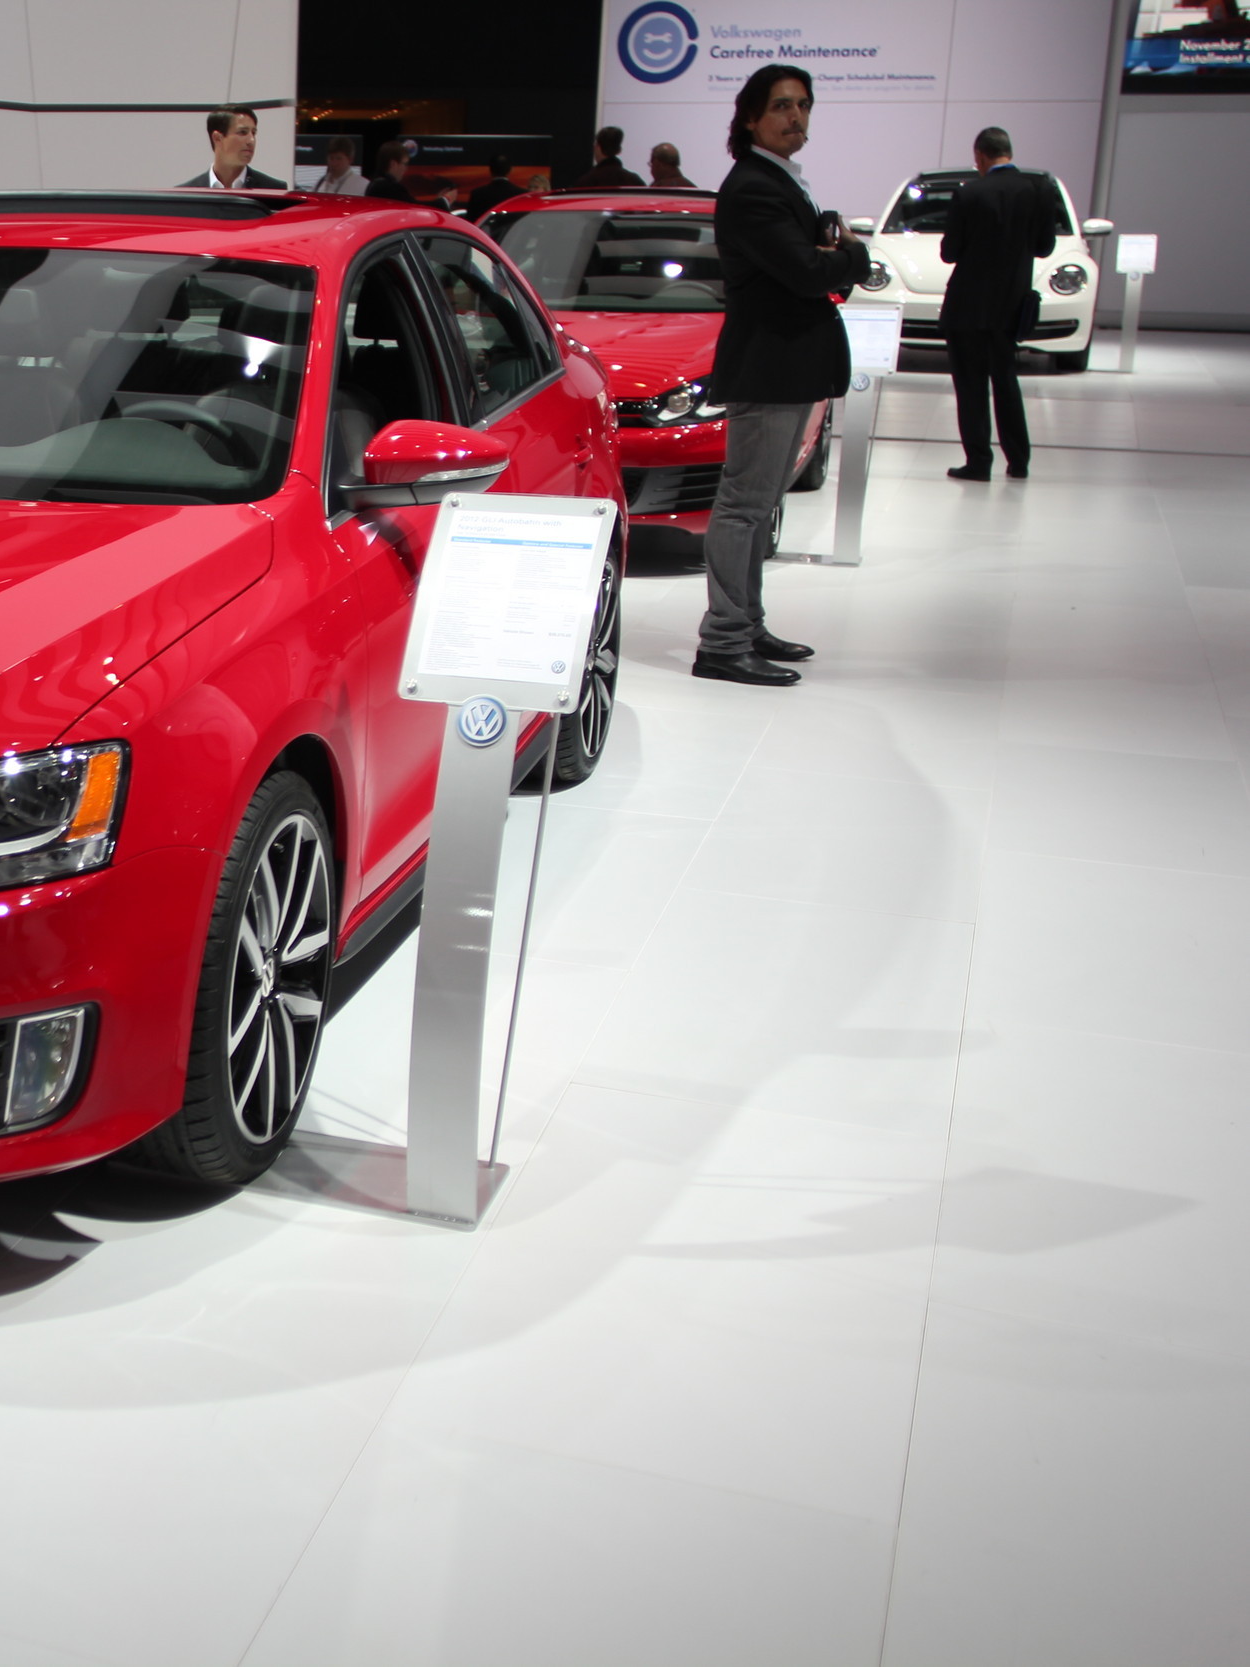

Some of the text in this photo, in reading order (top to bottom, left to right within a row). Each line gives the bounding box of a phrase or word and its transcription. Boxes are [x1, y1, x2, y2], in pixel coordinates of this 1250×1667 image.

[710, 25, 802, 41] Volkswagen
[1179, 39, 1241, 51] November
[709, 45, 878, 59] Carefree Maintenance
[1179, 52, 1244, 63] Installment
[541, 519, 563, 527] with
